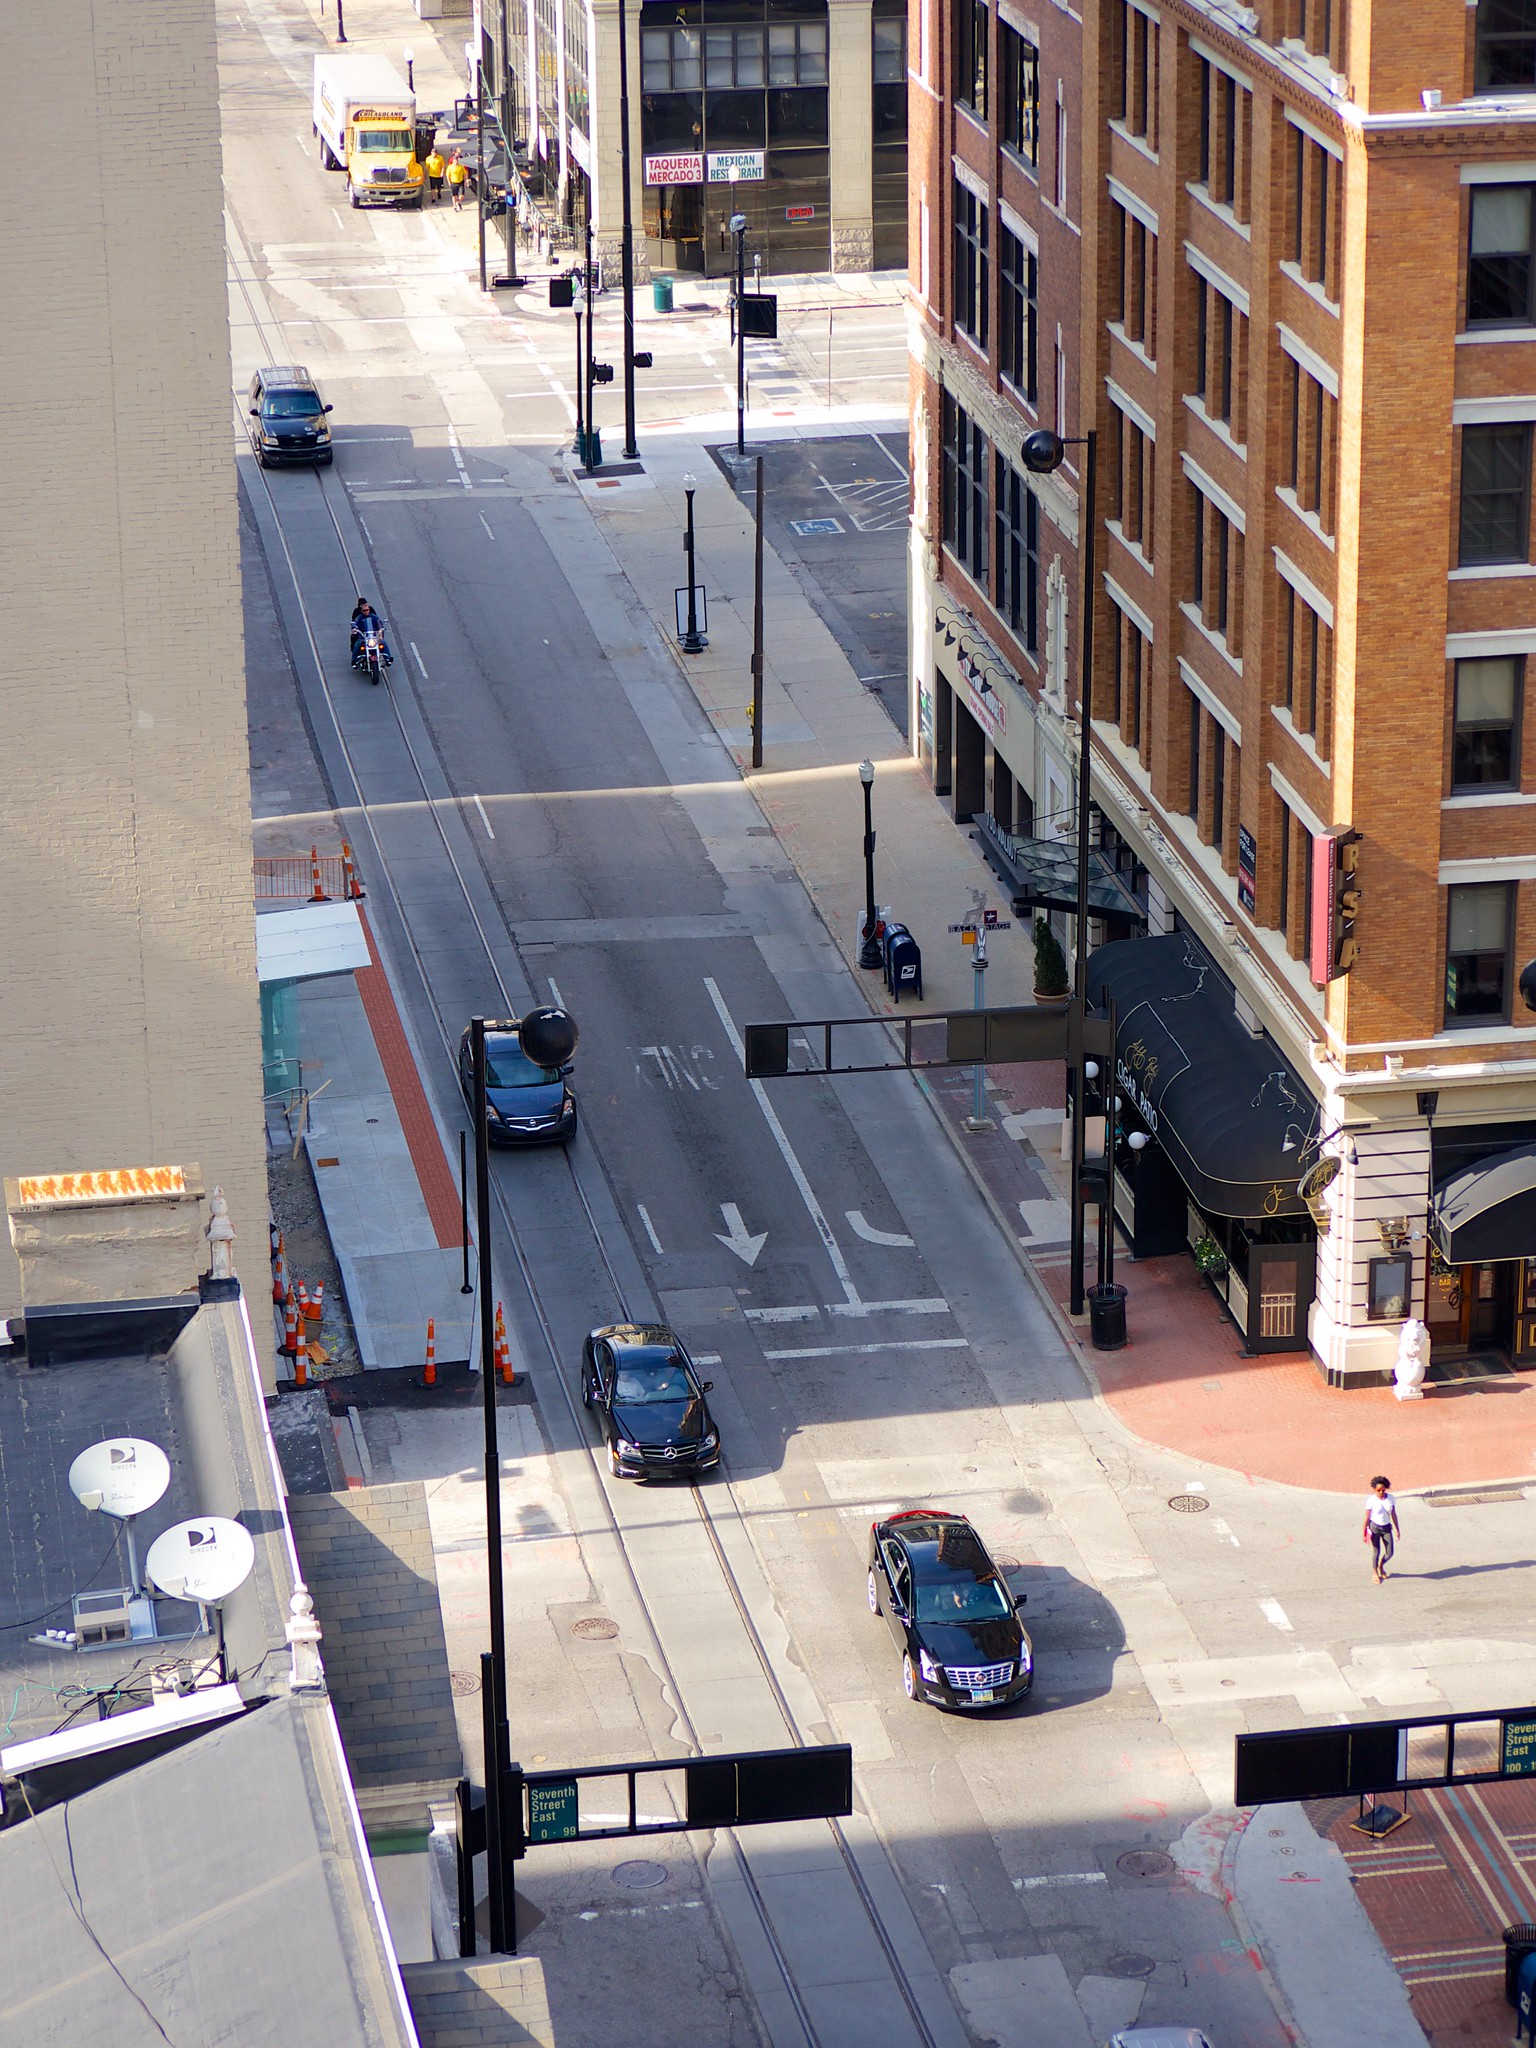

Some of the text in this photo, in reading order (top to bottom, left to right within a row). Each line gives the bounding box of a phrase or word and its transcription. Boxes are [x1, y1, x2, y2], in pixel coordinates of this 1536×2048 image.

[649, 157, 700, 170] TAQUERIA
[717, 155, 755, 167] MEXICAN
[649, 170, 702, 183] MERCADO 3
[710, 167, 762, 180] RESTRANT
[787, 207, 813, 218] OPEN
[1117, 1058, 1158, 1132] CIGAR PATIO
[190, 1545, 217, 1554] DIRECTV
[1506, 1745, 1529, 1757] East
[1506, 1762, 1521, 1773] 100
[531, 1786, 575, 1801] Seventh
[532, 1799, 566, 1812] Street
[532, 1811, 556, 1823] East
[541, 1829, 548, 1839] 0
[563, 1827, 576, 1837] 99
